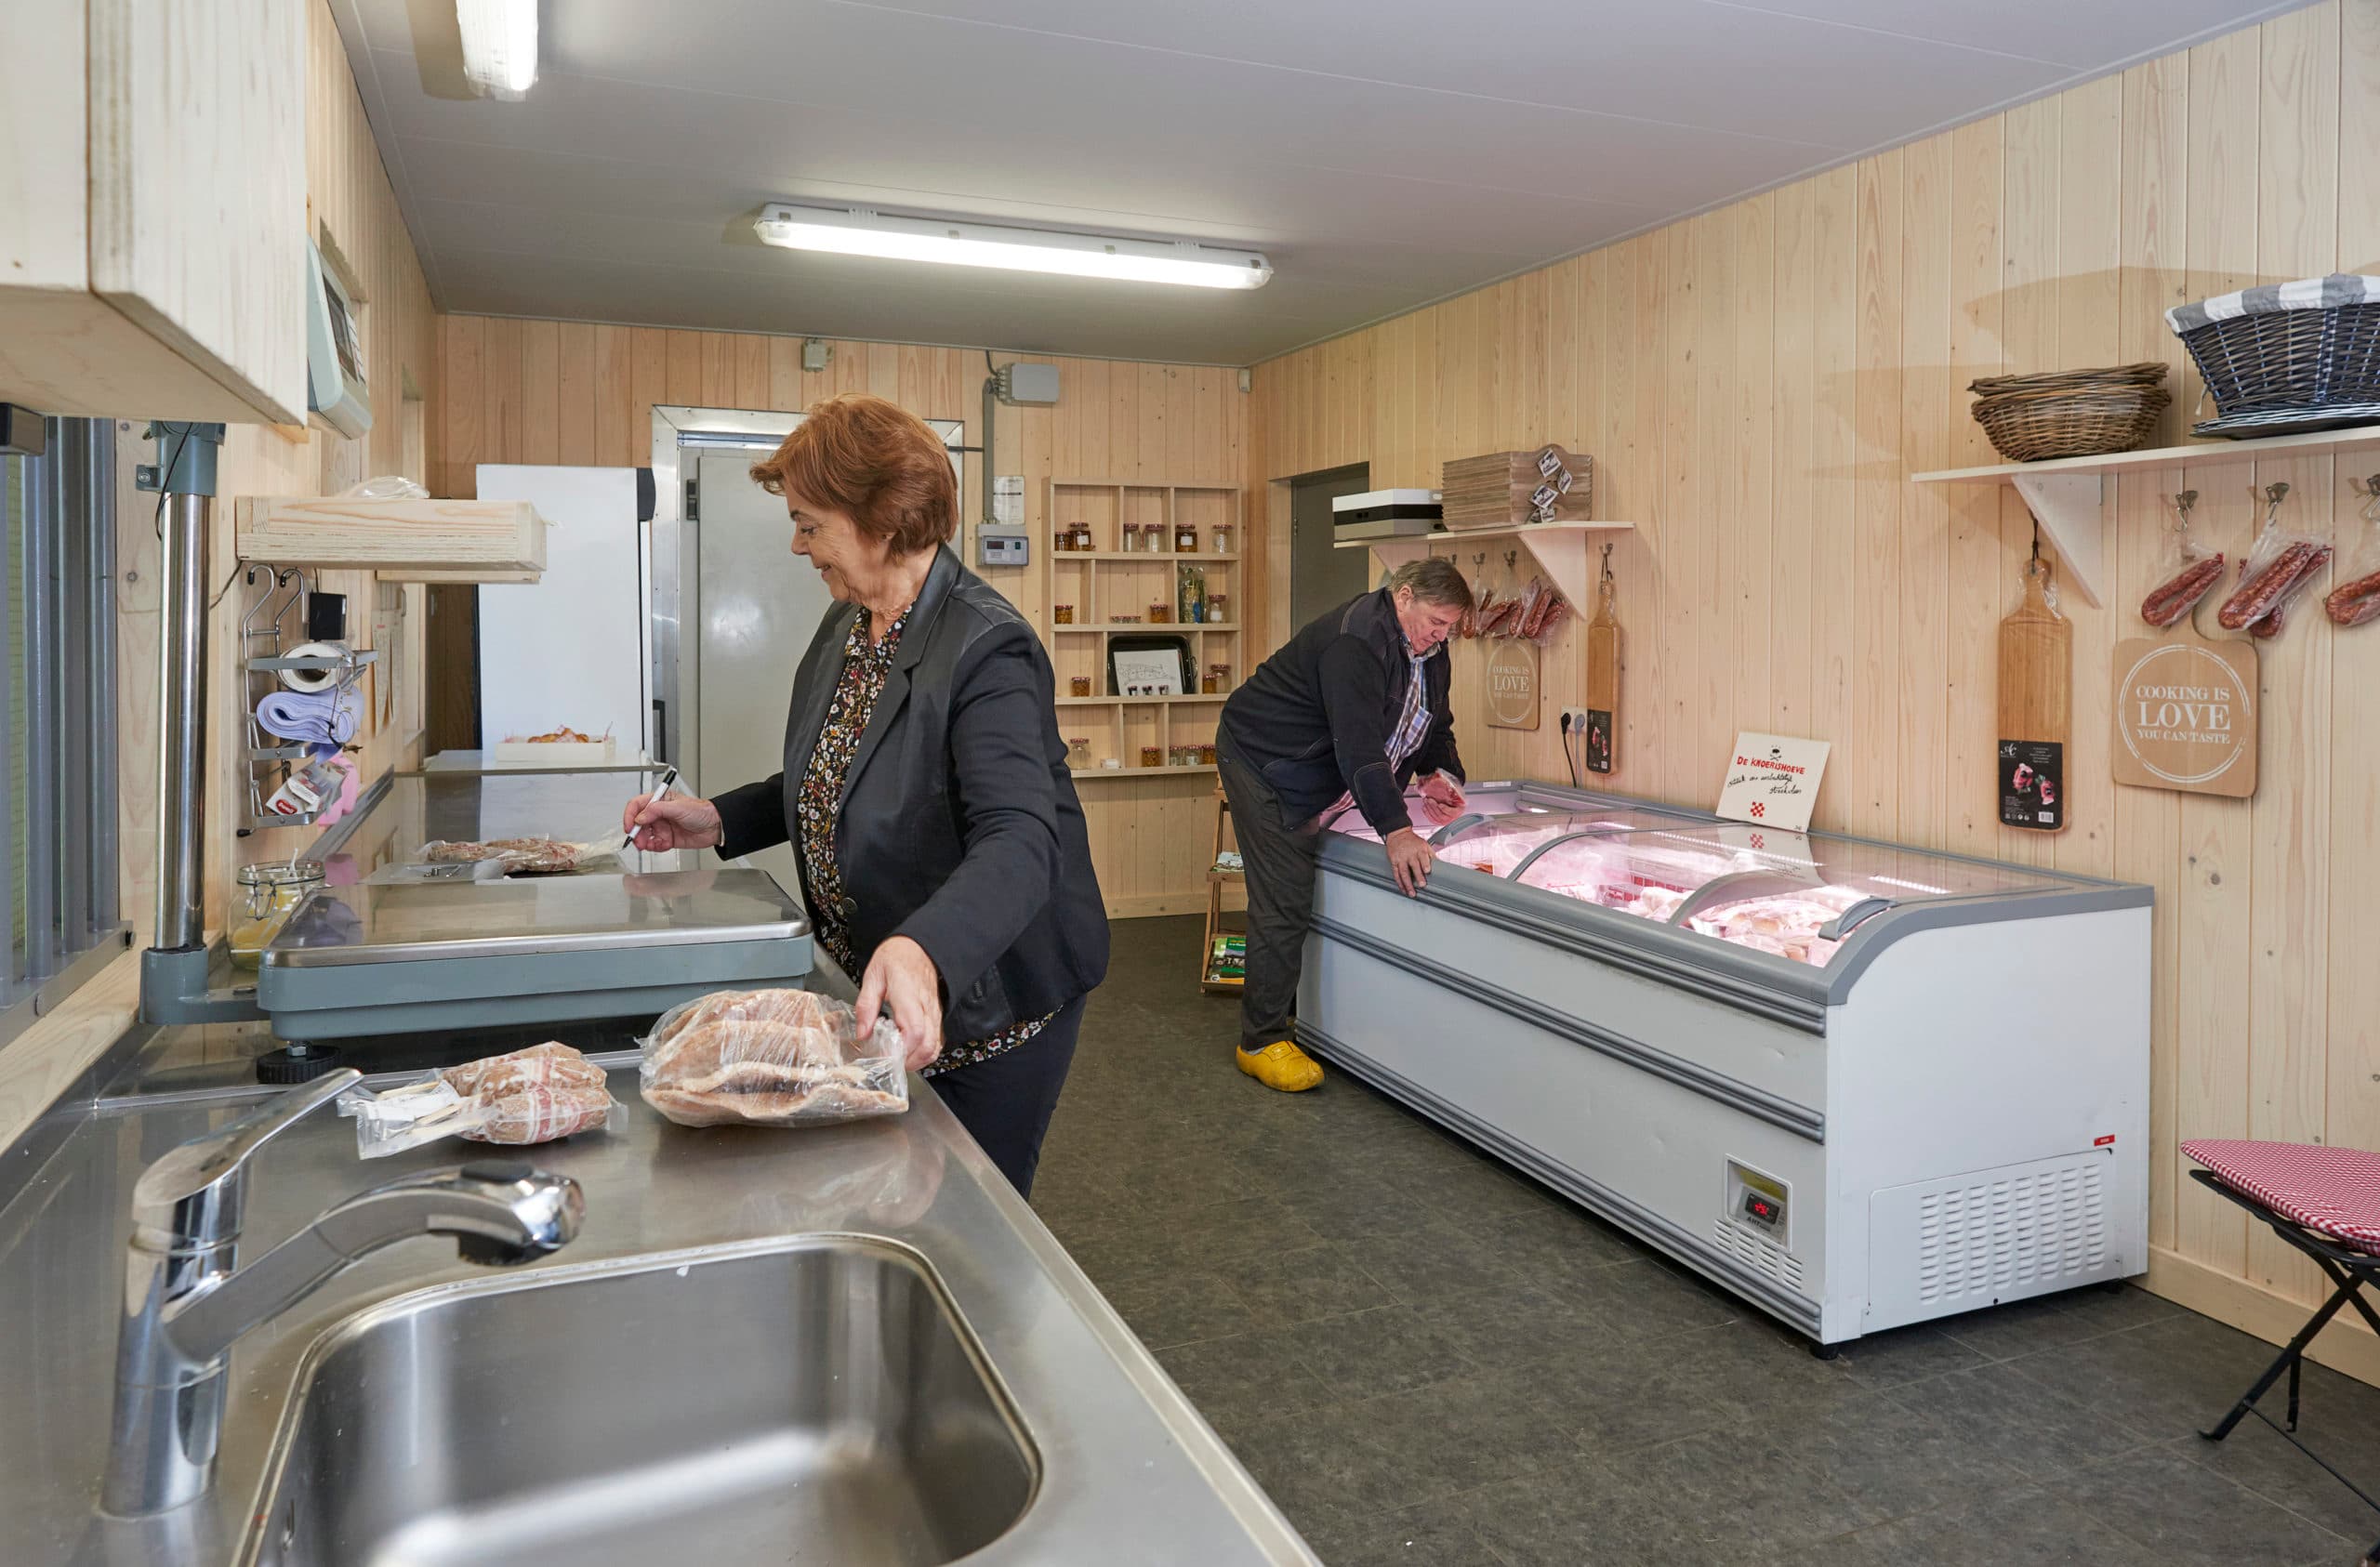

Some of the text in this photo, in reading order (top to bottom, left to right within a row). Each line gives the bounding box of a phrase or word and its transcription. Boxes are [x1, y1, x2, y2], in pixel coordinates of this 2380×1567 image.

[1494, 675, 1530, 691] LOVE
[2135, 685, 2230, 701] COOKING IS
[2136, 701, 2231, 731] LOVE
[2136, 729, 2230, 744] YOU CAN TASTE
[1737, 756, 1749, 766] DE
